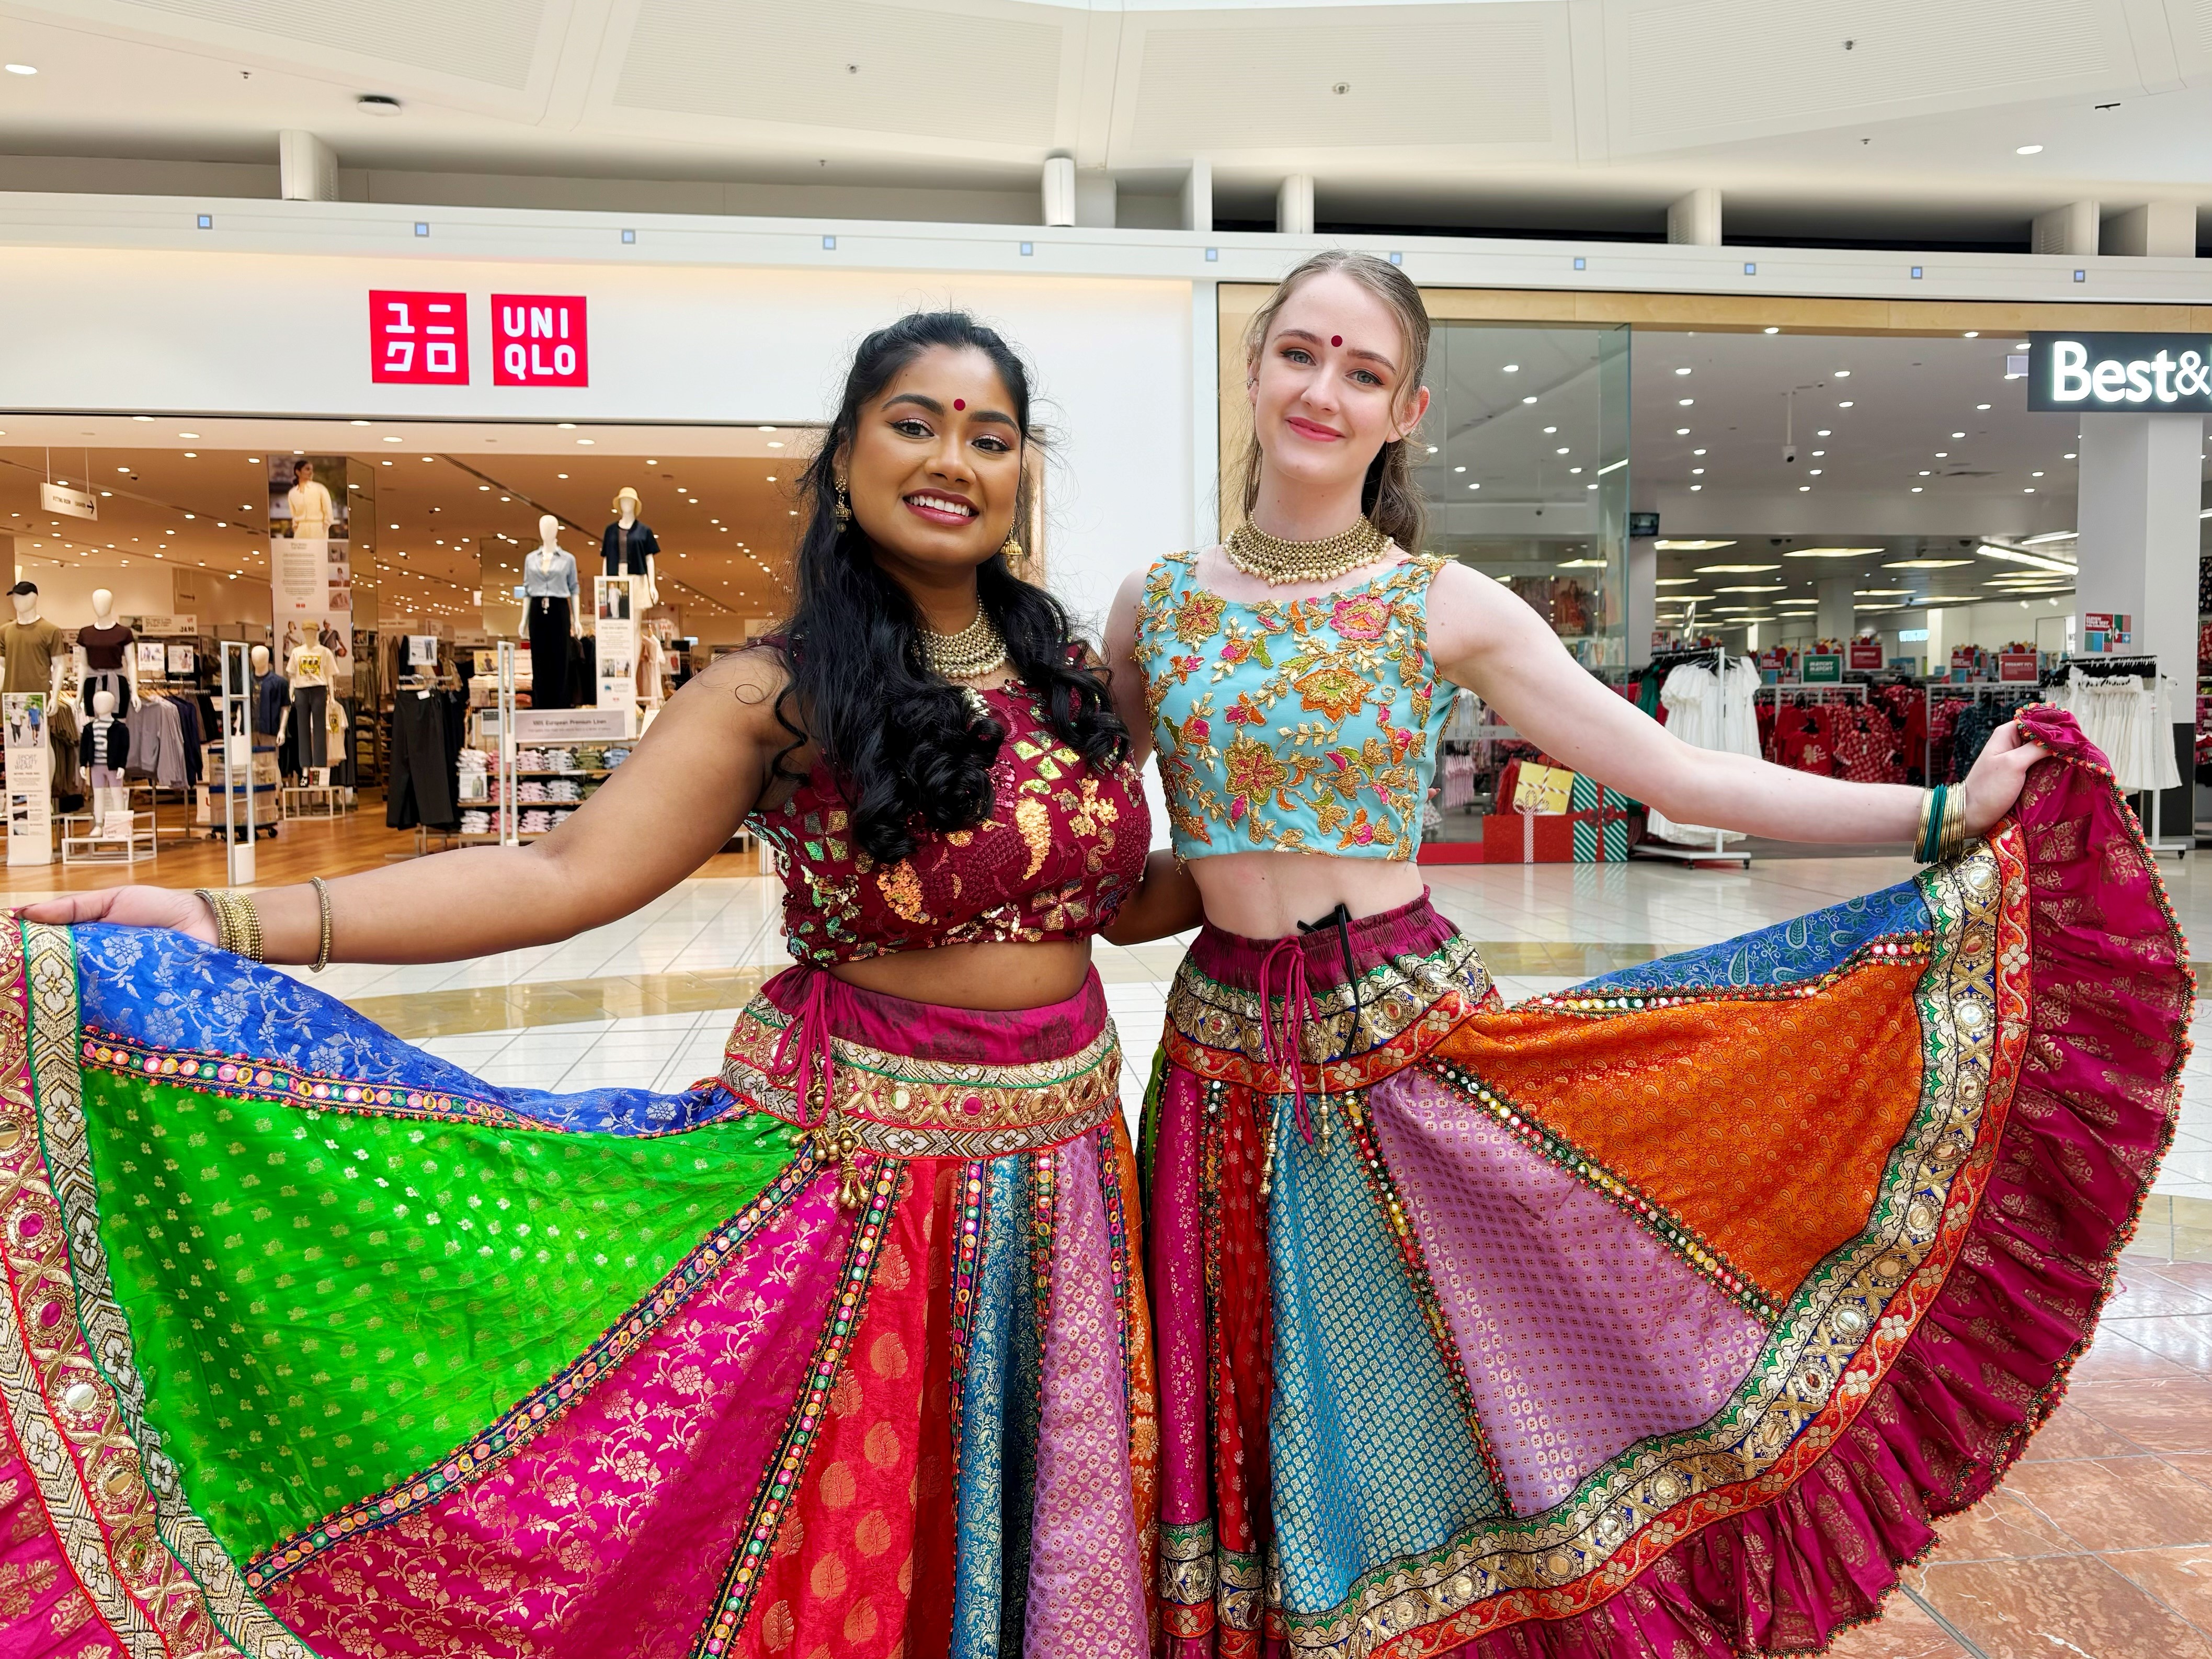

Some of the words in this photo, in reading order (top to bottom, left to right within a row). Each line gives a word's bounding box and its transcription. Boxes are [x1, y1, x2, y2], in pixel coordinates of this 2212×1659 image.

[503, 306, 569, 338] UNI
[504, 344, 576, 380] QLO
[2053, 340, 2212, 403] Best&
